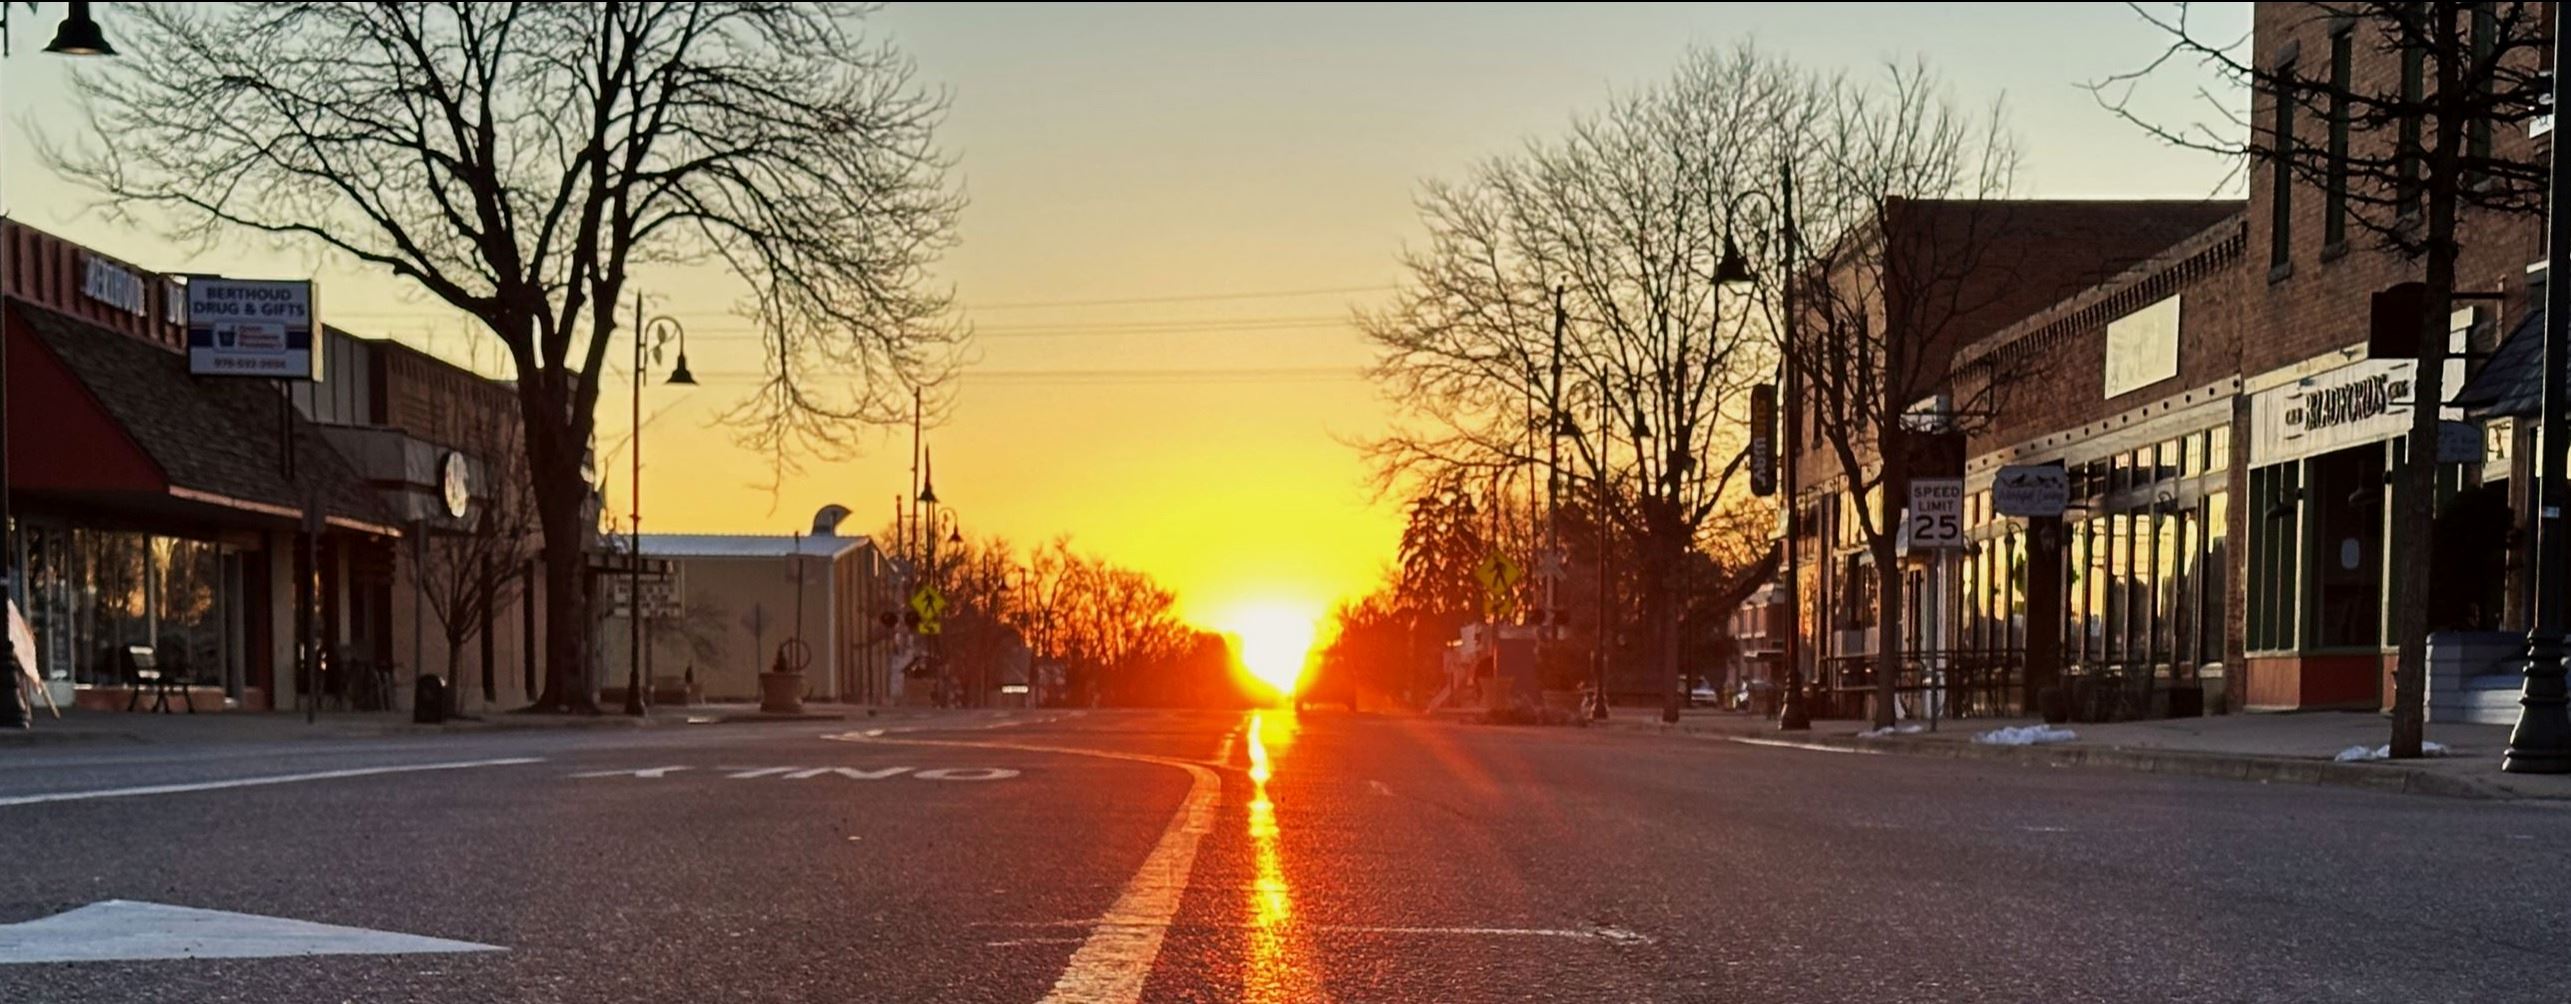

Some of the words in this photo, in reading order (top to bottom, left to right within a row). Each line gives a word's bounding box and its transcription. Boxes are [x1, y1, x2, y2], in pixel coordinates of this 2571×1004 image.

[206, 286, 292, 301] BERTHOUD
[193, 301, 239, 315] DRUG
[244, 303, 256, 316] &
[261, 303, 305, 317] GIFTS
[1914, 486, 1960, 498] SPEED
[1918, 501, 1954, 512] LIMIT
[1914, 514, 1958, 540] 25
